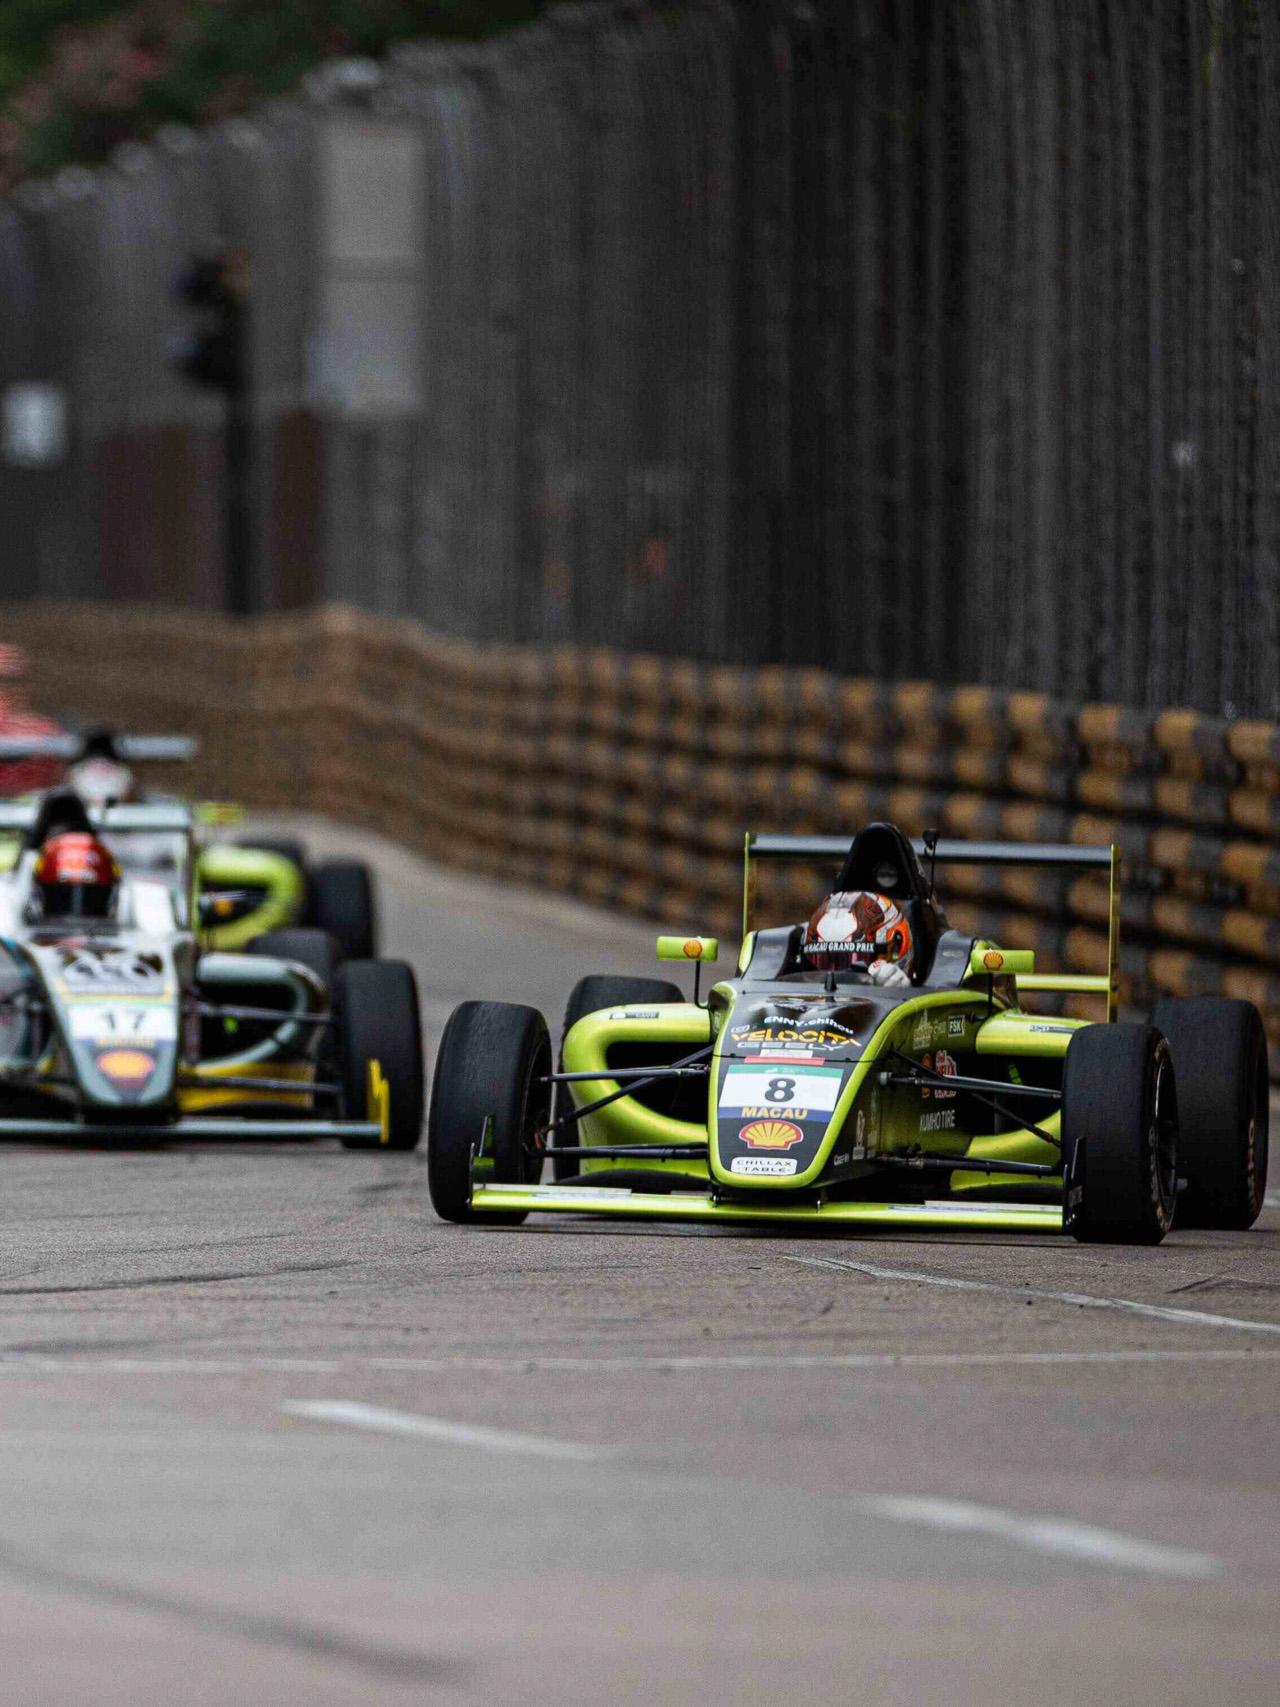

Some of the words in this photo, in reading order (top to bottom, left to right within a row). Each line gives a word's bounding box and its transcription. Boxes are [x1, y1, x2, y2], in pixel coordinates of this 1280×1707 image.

[828, 941, 856, 952] GRAND
[856, 942, 875, 953] PRIX
[102, 1009, 147, 1032] 17
[730, 1028, 862, 1047] VELOCITA
[764, 1077, 796, 1103] 8
[741, 1106, 808, 1120] MACAU
[941, 1109, 956, 1128] TIRE
[736, 1159, 792, 1167] CHILLAX
